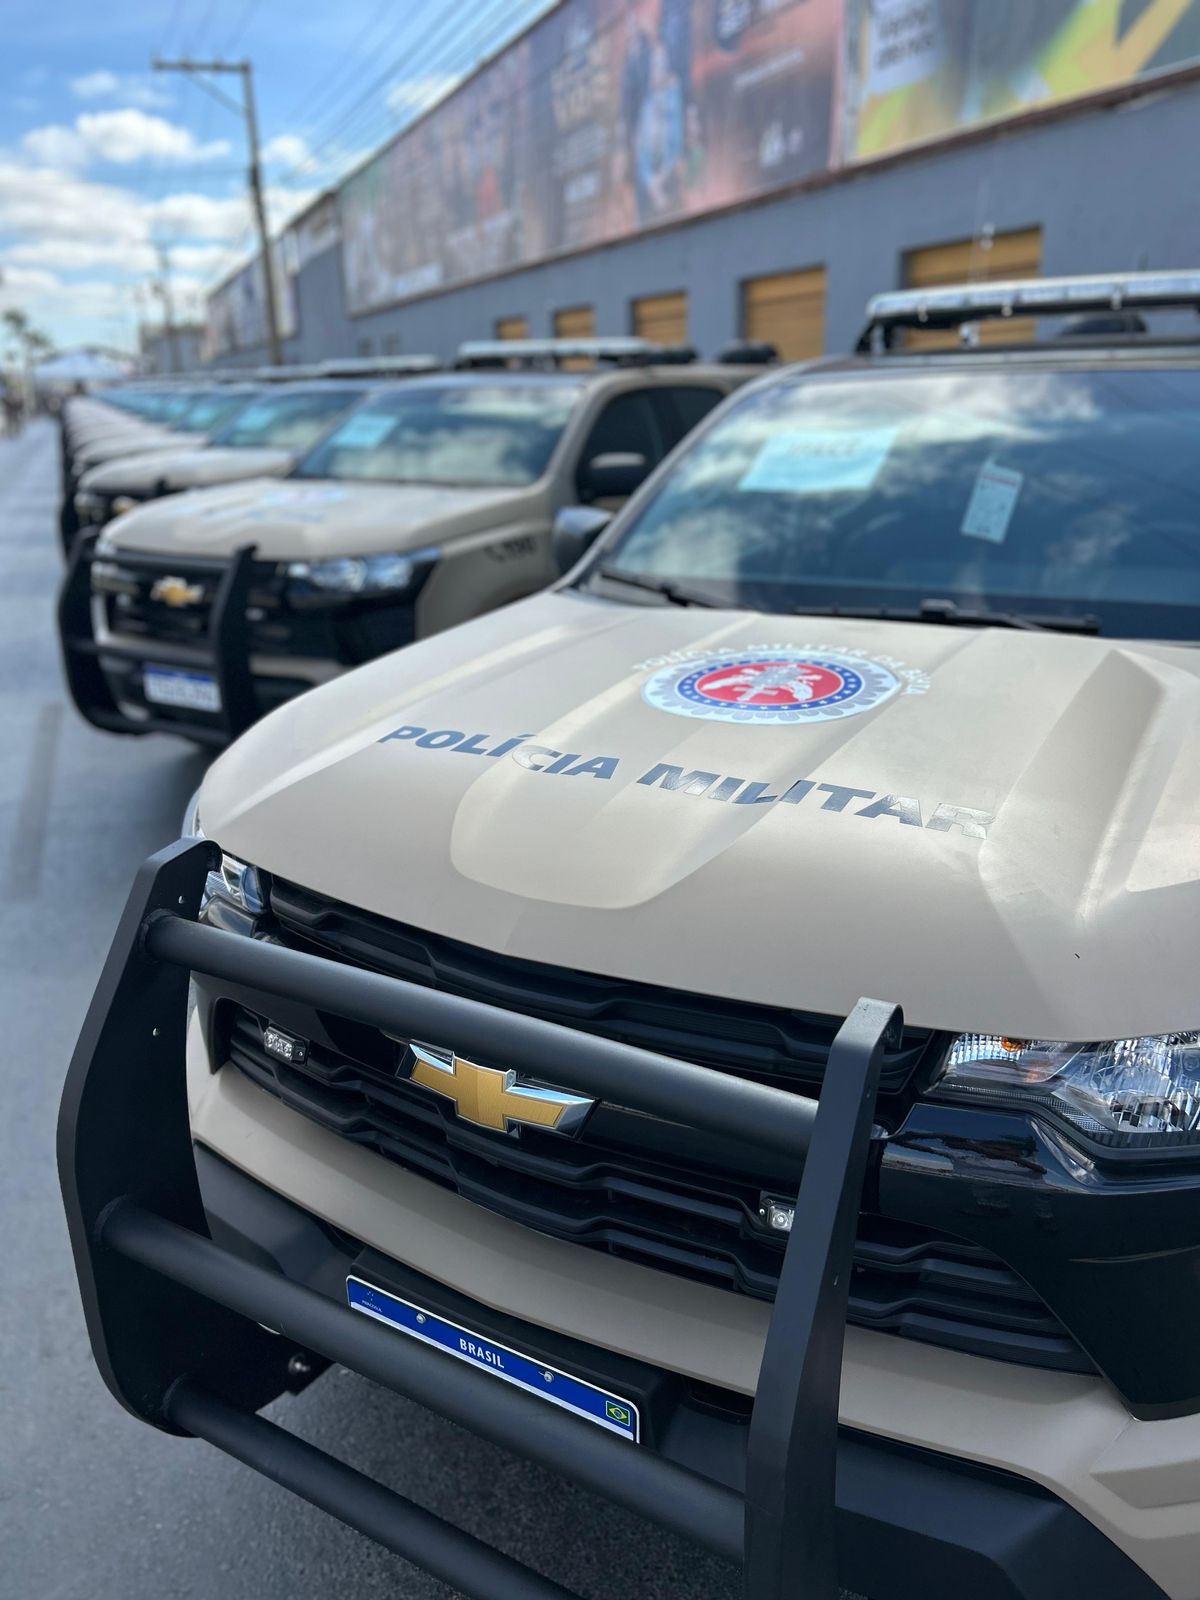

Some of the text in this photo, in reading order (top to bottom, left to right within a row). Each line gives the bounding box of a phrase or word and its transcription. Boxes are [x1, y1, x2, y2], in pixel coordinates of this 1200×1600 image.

[376, 726, 996, 840] POLÍCIA MILITAR
[459, 1338, 505, 1369] BRASIL
